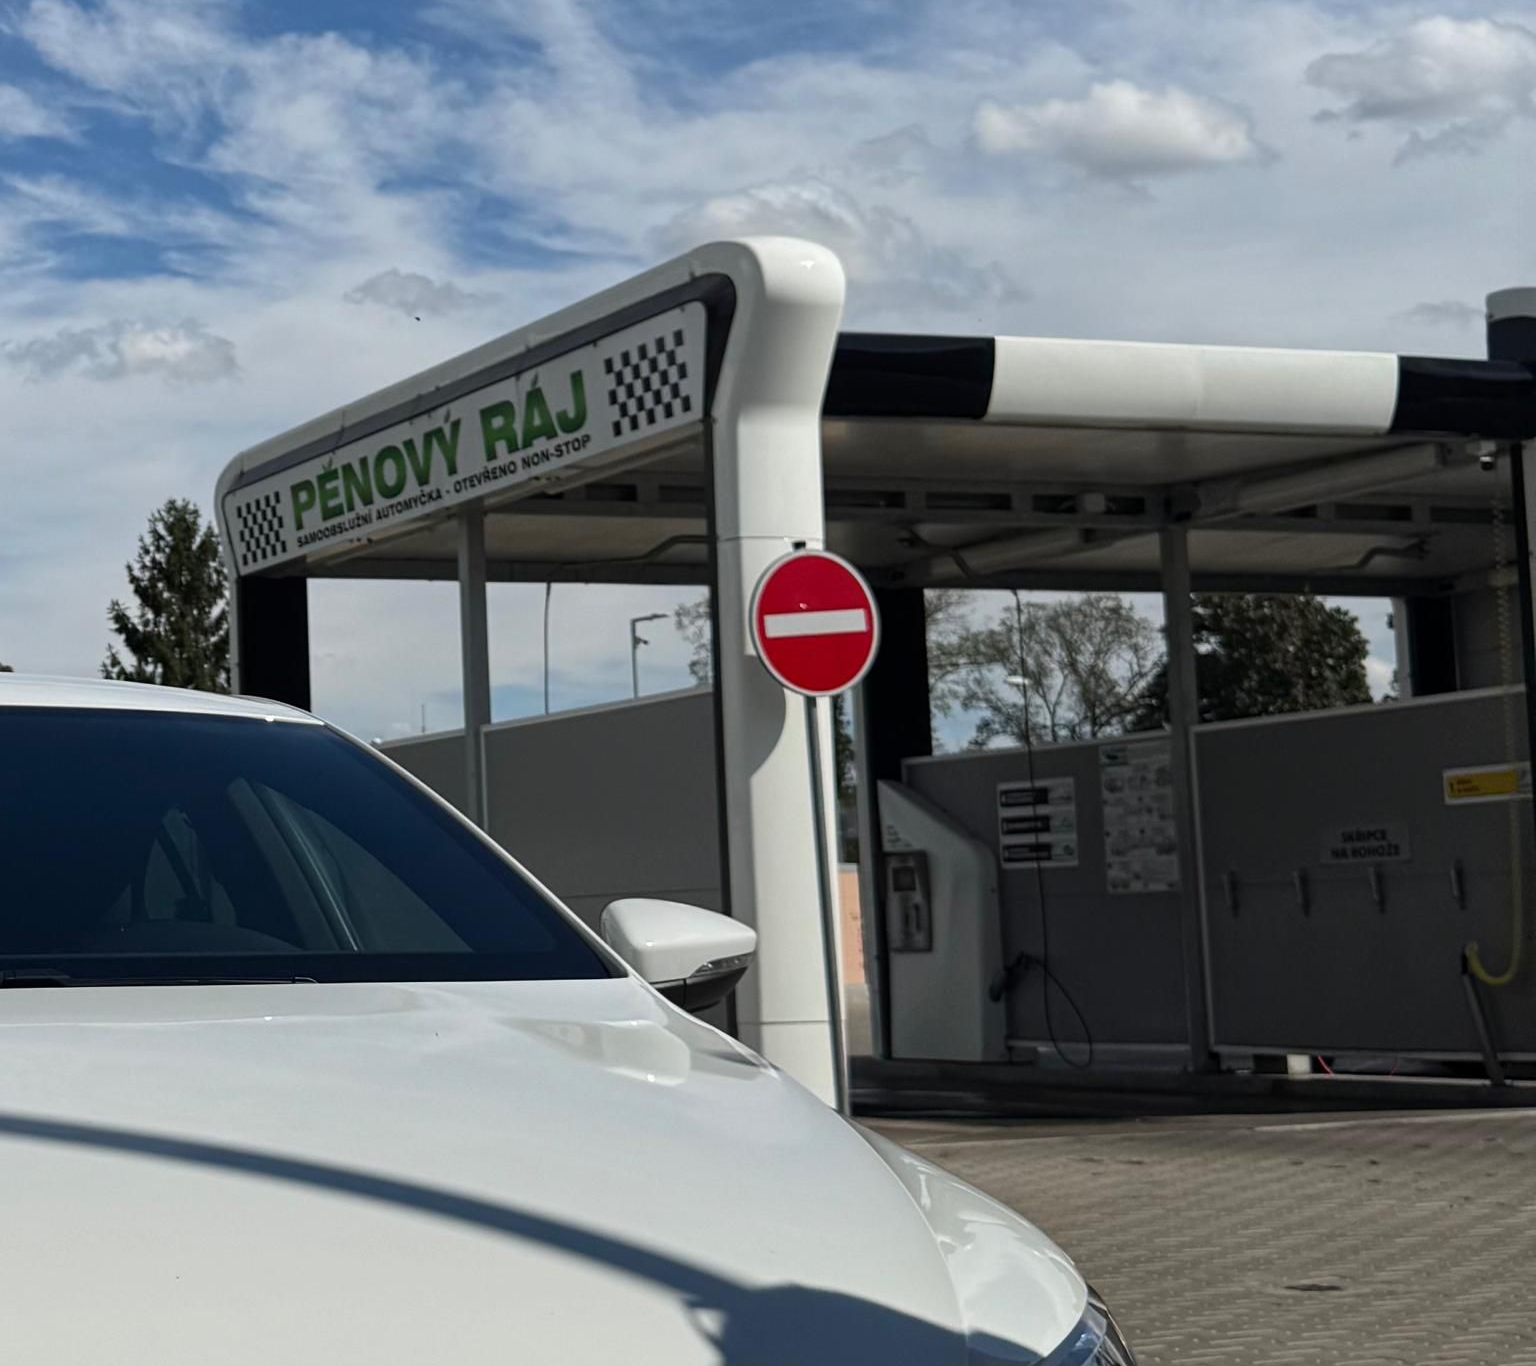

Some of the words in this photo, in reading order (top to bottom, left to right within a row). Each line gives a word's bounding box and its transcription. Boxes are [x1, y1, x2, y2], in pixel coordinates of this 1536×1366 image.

[290, 407, 462, 531] PĚNOVÝ
[478, 369, 587, 462] RÁJ
[296, 507, 374, 548] SAMOOBSLUŽNÍ
[375, 488, 443, 522] AUTOMYČKA
[453, 460, 518, 494] OTEVŘENO
[520, 433, 591, 470] NON-STOP
